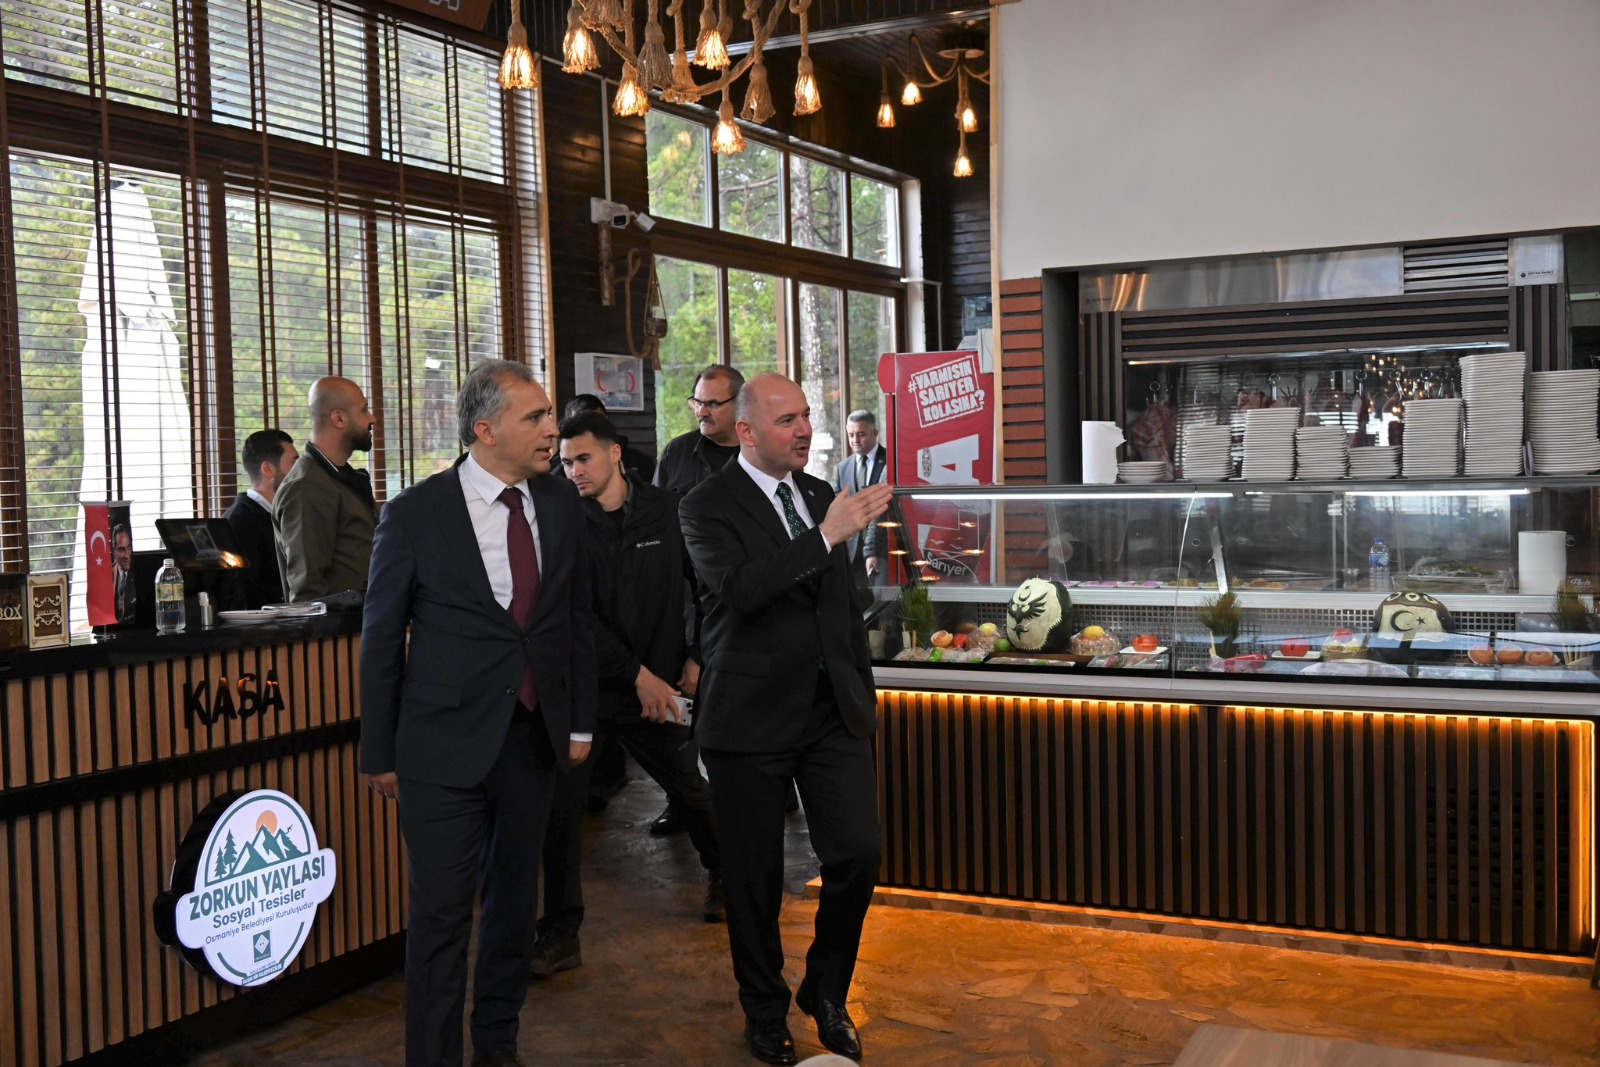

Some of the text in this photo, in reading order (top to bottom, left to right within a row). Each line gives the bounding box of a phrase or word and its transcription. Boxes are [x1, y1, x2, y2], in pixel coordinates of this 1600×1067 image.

[919, 376, 975, 406] SARIYER
[923, 389, 985, 421] KOLASINA?
[183, 670, 285, 729] KASA
[190, 855, 325, 920] ZORKUN YAYLASI
[213, 888, 306, 928] Sosyal Tesisler
[205, 901, 314, 944] Osmaniye Belediyesi Kuruluşudur
